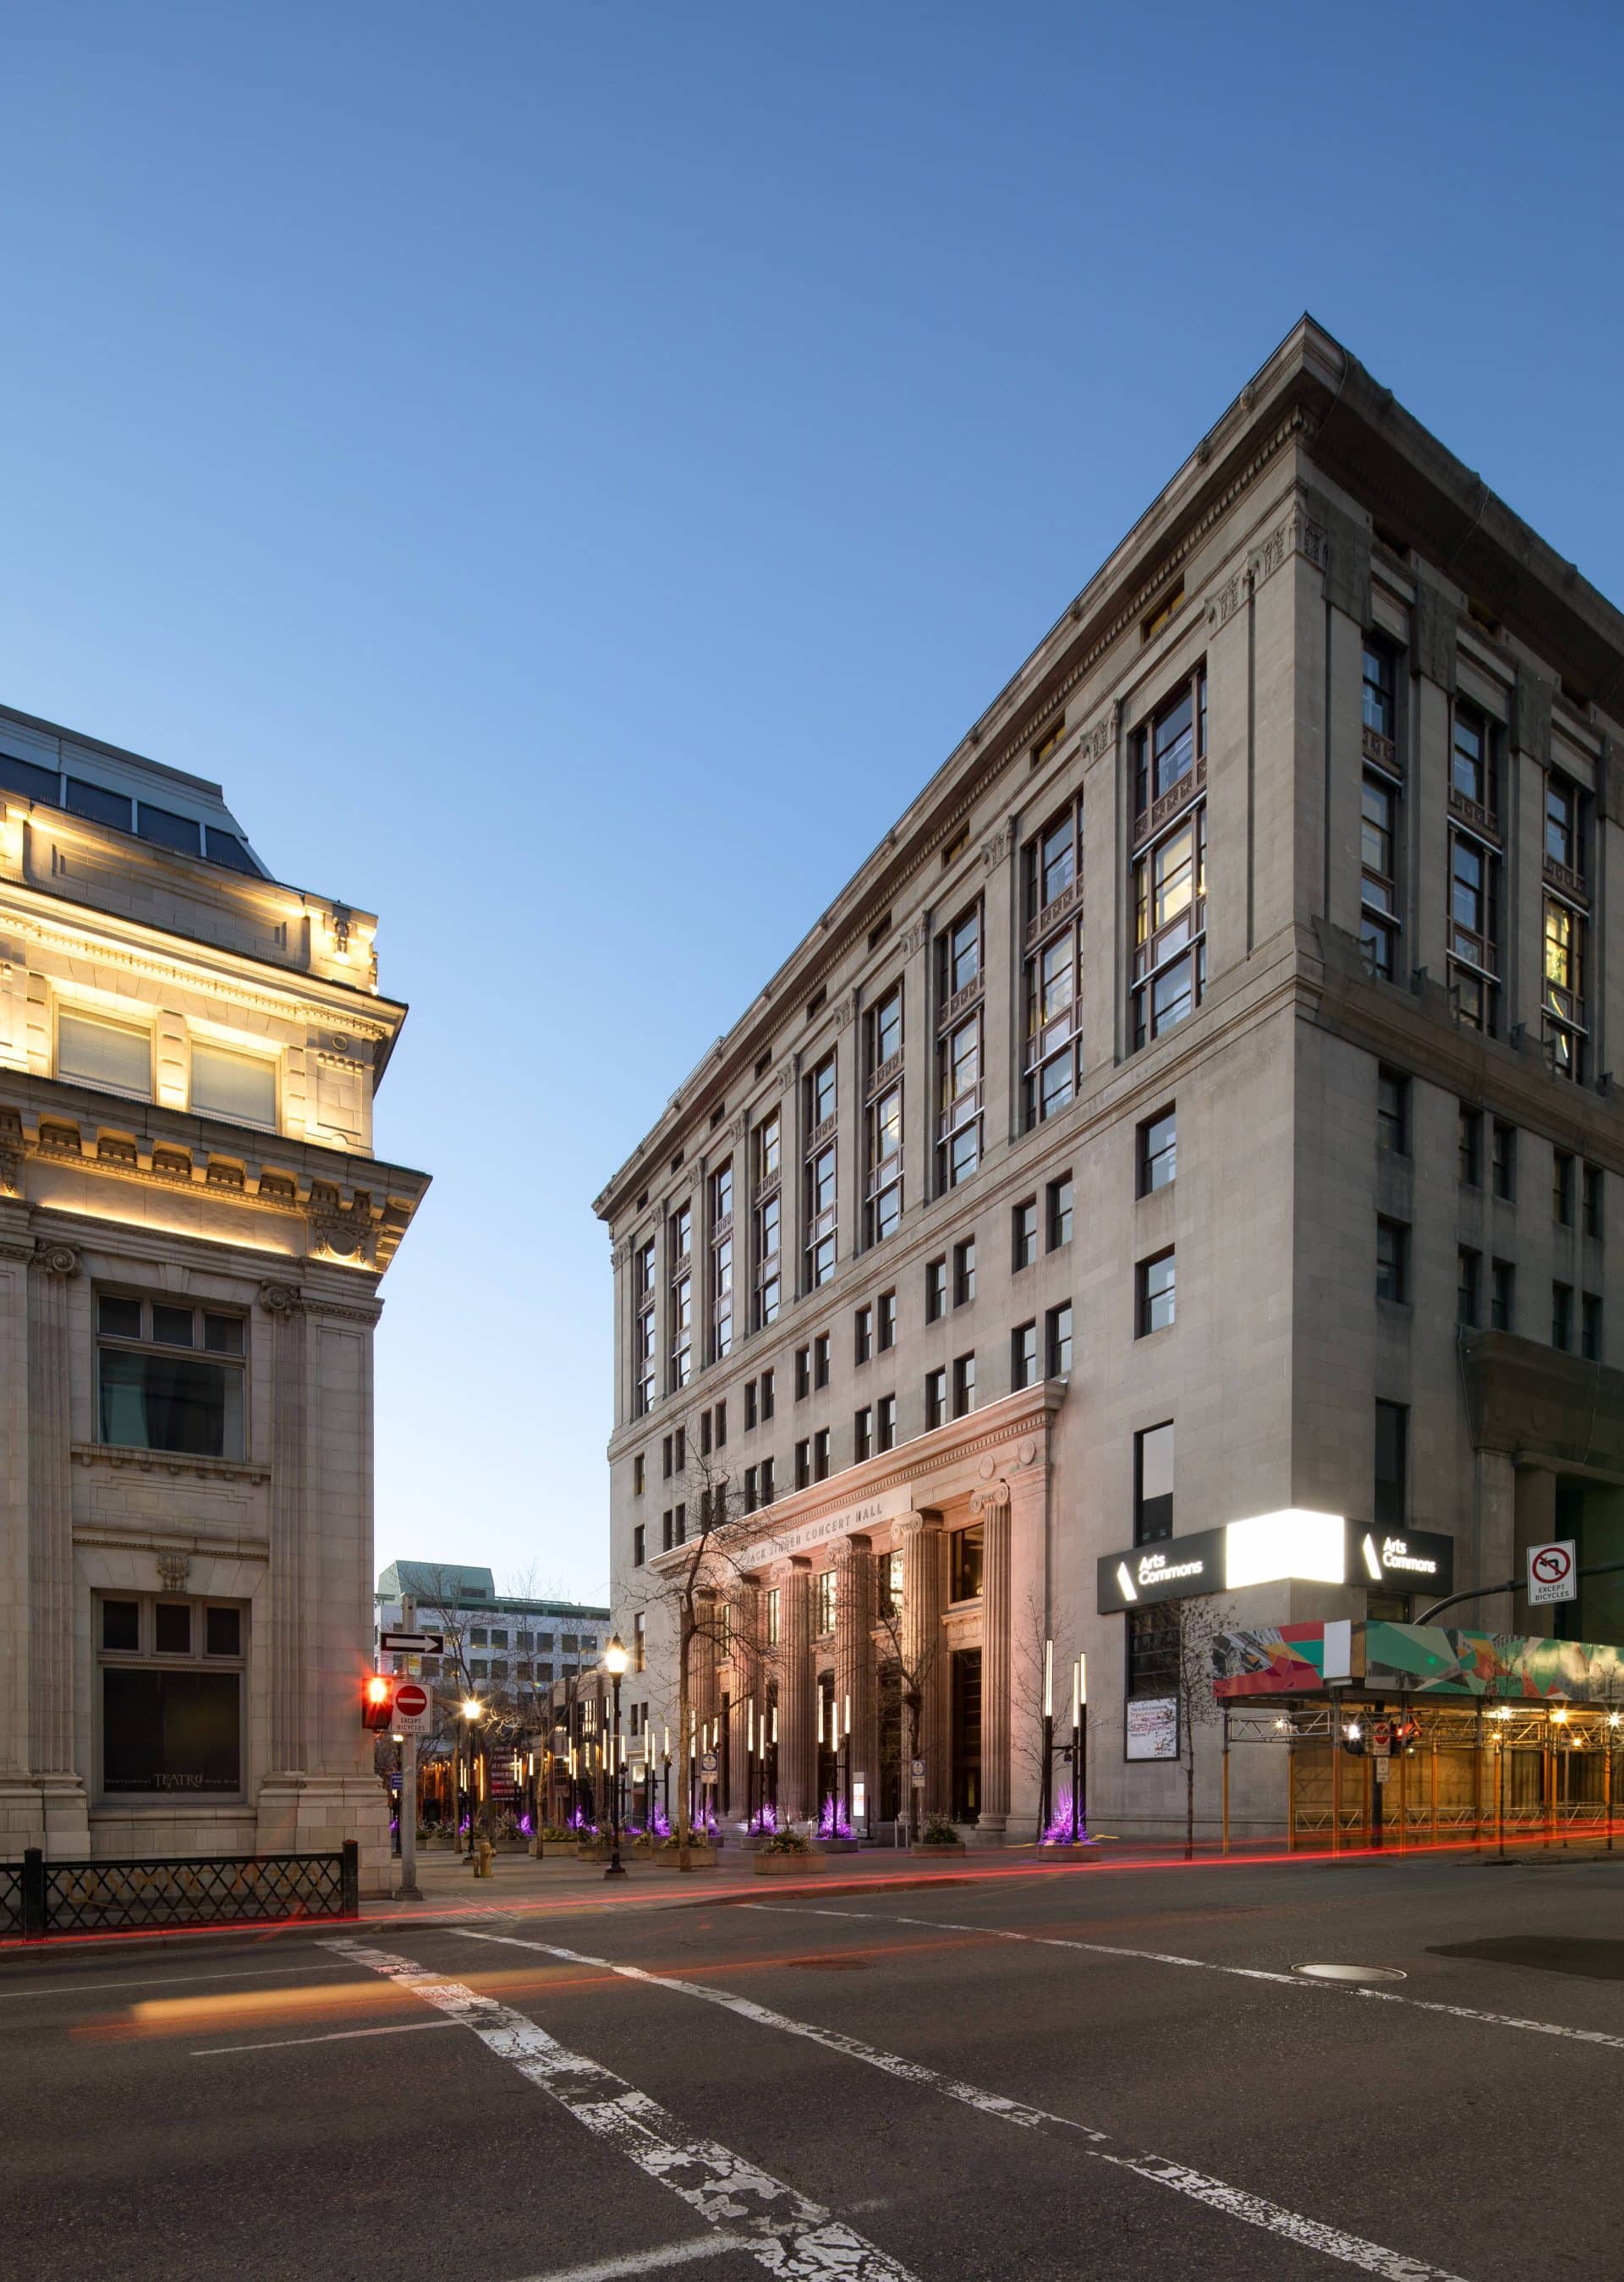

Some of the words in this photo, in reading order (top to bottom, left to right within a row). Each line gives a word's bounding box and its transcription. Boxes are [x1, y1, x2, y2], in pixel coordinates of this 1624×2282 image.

[746, 1547, 766, 1564] JACK
[769, 1534, 801, 1555] SINGER
[805, 1515, 851, 1542] CONCERT
[855, 1503, 882, 1523] HALL
[1383, 1537, 1407, 1555] Arts
[1138, 1555, 1166, 1571] Arts
[1382, 1551, 1436, 1573] Commons
[1138, 1561, 1203, 1585] Commons
[1535, 1591, 1570, 1601] BICYCLES
[1539, 1583, 1565, 1594] EXCEPT
[153, 1773, 203, 1787] TEATRO
